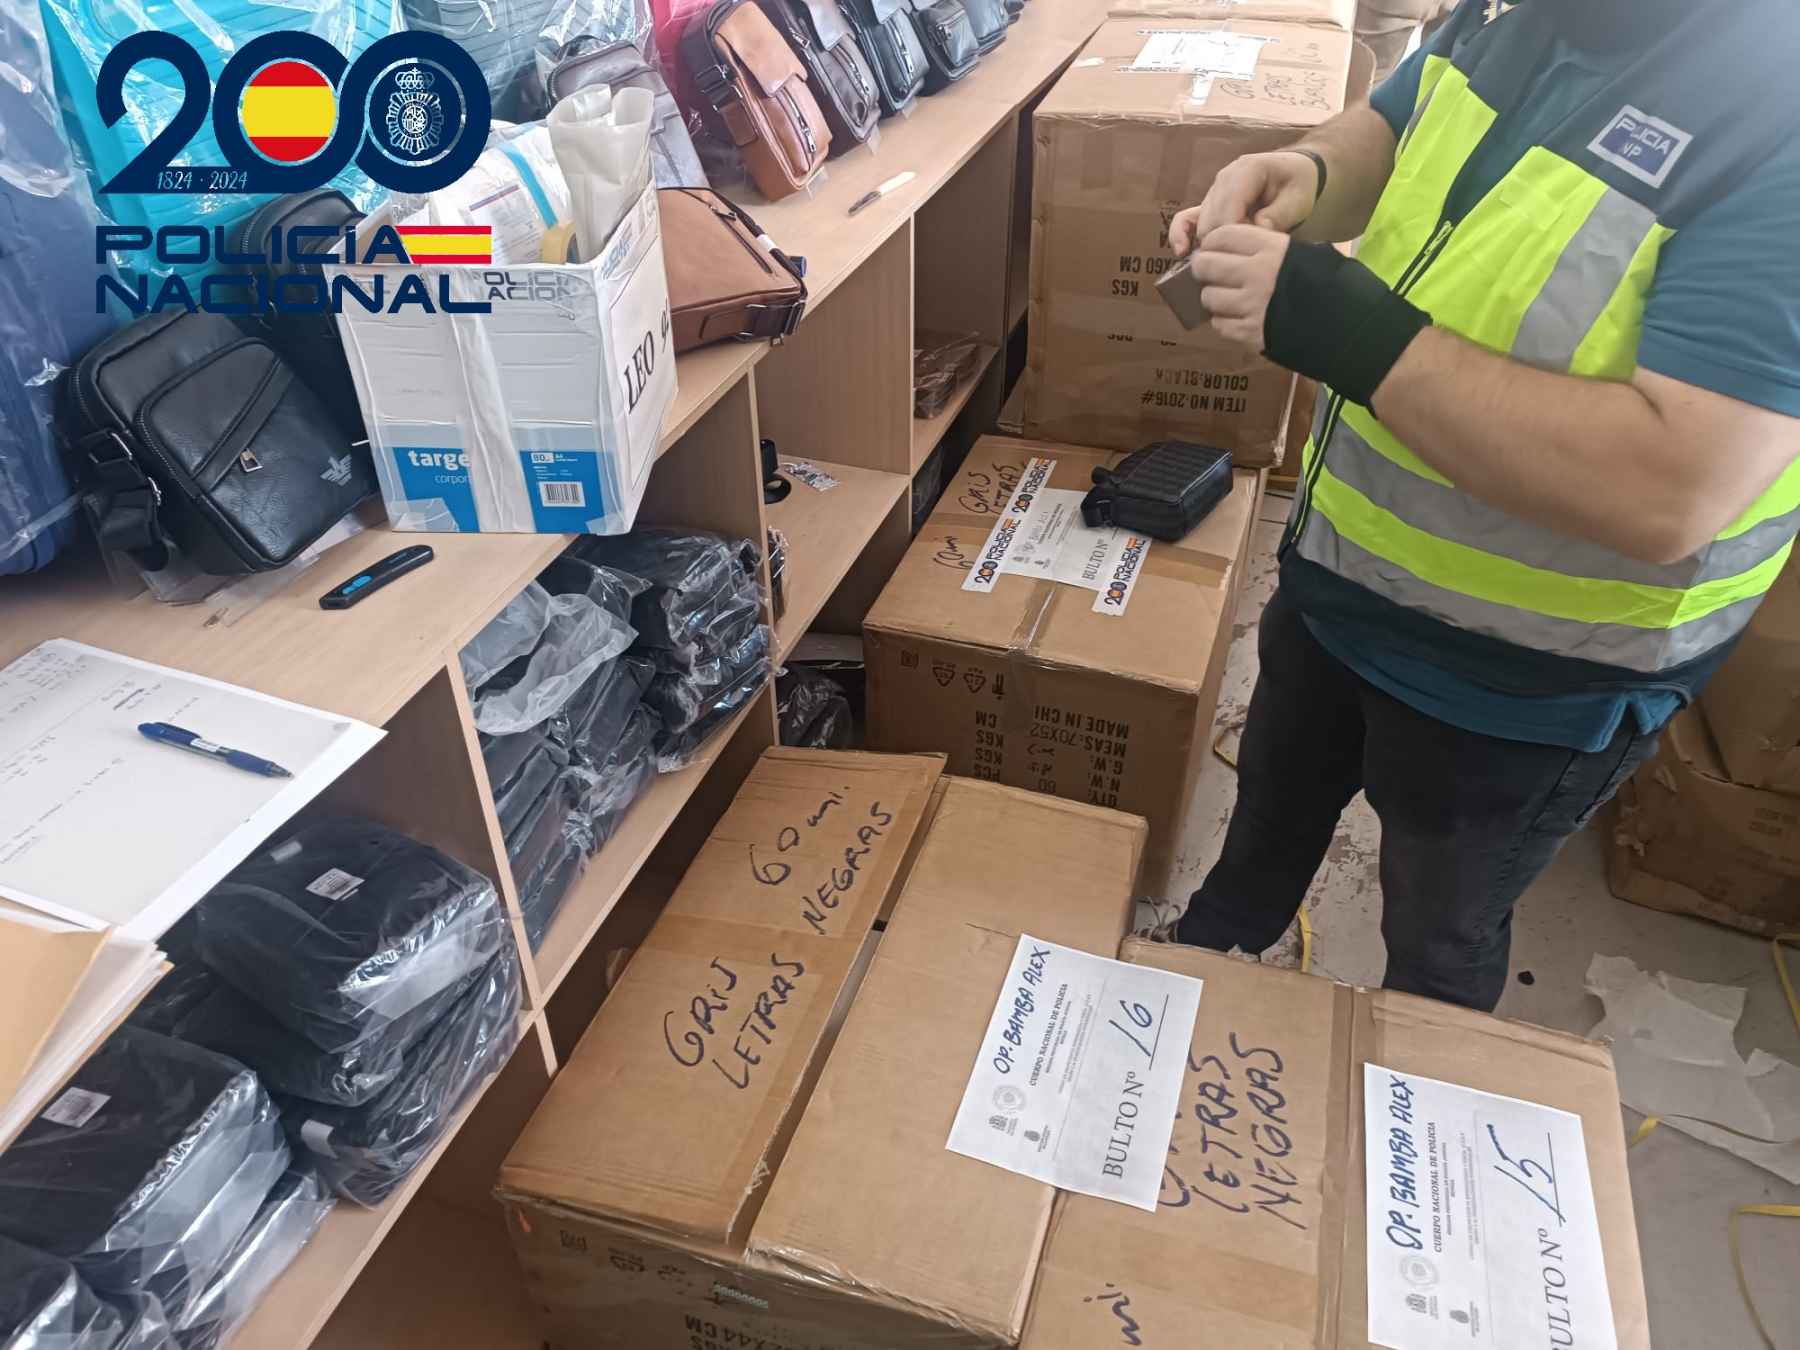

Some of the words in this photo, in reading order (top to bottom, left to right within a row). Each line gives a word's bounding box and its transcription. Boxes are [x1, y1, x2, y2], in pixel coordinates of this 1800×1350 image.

[1111, 279, 1139, 297] KGS
[1120, 256, 1142, 273] CM
[624, 330, 655, 415] LEO
[1214, 396, 1247, 413] ITEM
[407, 450, 472, 471] targe
[975, 711, 998, 728] CM
[976, 729, 1004, 748] KGS
[1065, 711, 1081, 728] IN
[1085, 716, 1130, 739] MADE
[975, 747, 1003, 765] KGS
[750, 826, 800, 886] 60
[802, 801, 893, 936] NEGRAS
[711, 952, 806, 1090] LETRAS
[1003, 987, 1035, 1047] BAMBA
[1022, 945, 1051, 986] ALEX
[1108, 1000, 1153, 1058] 16
[1389, 1074, 1415, 1125] ALEX
[1102, 1097, 1140, 1180] BULTO
[1228, 1031, 1308, 1231] NEGRAS
[1388, 1126, 1420, 1209] BAMBA
[1487, 1123, 1567, 1224] 15
[1432, 1214, 1443, 1253] CUERPO
[1542, 1267, 1575, 1350] ULTO
